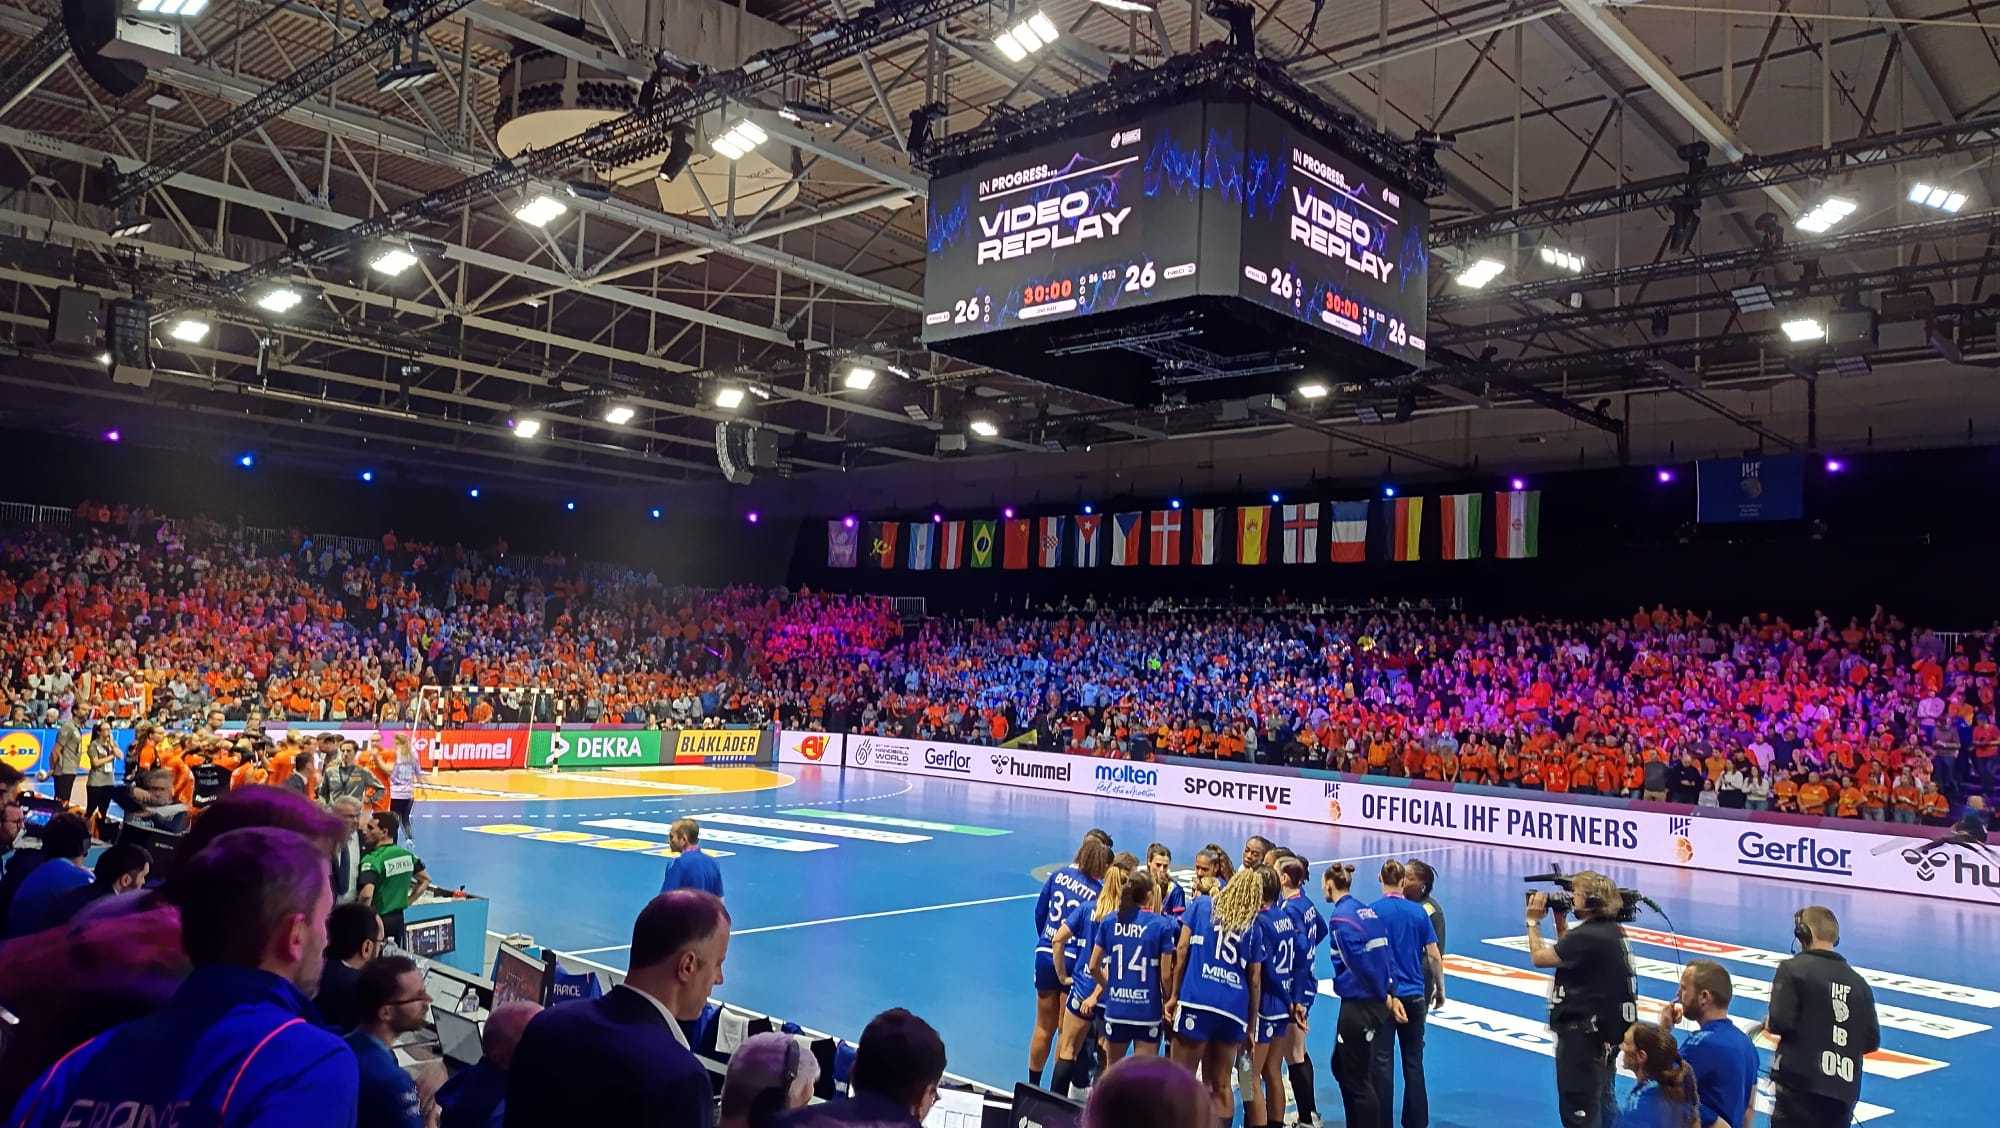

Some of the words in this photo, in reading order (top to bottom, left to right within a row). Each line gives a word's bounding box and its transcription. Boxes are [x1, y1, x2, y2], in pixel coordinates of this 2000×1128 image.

[1293, 148, 1302, 164] IN
[979, 180, 990, 193] IN
[979, 191, 1089, 237] VIDEO
[1292, 186, 1371, 247] VIDEO
[977, 207, 1132, 265] REPLAY
[1290, 215, 1394, 284] REPLAY
[1125, 262, 1156, 292] 26
[1270, 267, 1293, 299] 26
[1024, 280, 1072, 305] 30:00
[1326, 291, 1359, 320] 30:00
[955, 297, 980, 324] 26
[1389, 319, 1406, 346] 26
[577, 737, 642, 758] DEKRA
[680, 732, 756, 752] BLÅKLÄDER
[876, 753, 909, 762] WORLD
[925, 748, 970, 770] Gerflor
[1011, 757, 1071, 782] hummel
[1096, 764, 1157, 785] molten
[1184, 777, 1291, 805] SPORTFIVE
[1324, 782, 1341, 800] IHF
[1362, 793, 1457, 829] OFFICIAL
[1464, 804, 1500, 833] IHF
[1507, 808, 1638, 849] PARTNERS
[1669, 816, 1692, 837] IHF
[1738, 831, 1852, 869] Gerflor
[1114, 922, 1147, 938] DURY
[1214, 925, 1240, 965] 15
[1276, 937, 1294, 974] 21
[1112, 944, 1147, 982] 14
[1110, 988, 1150, 1000] MILLET
